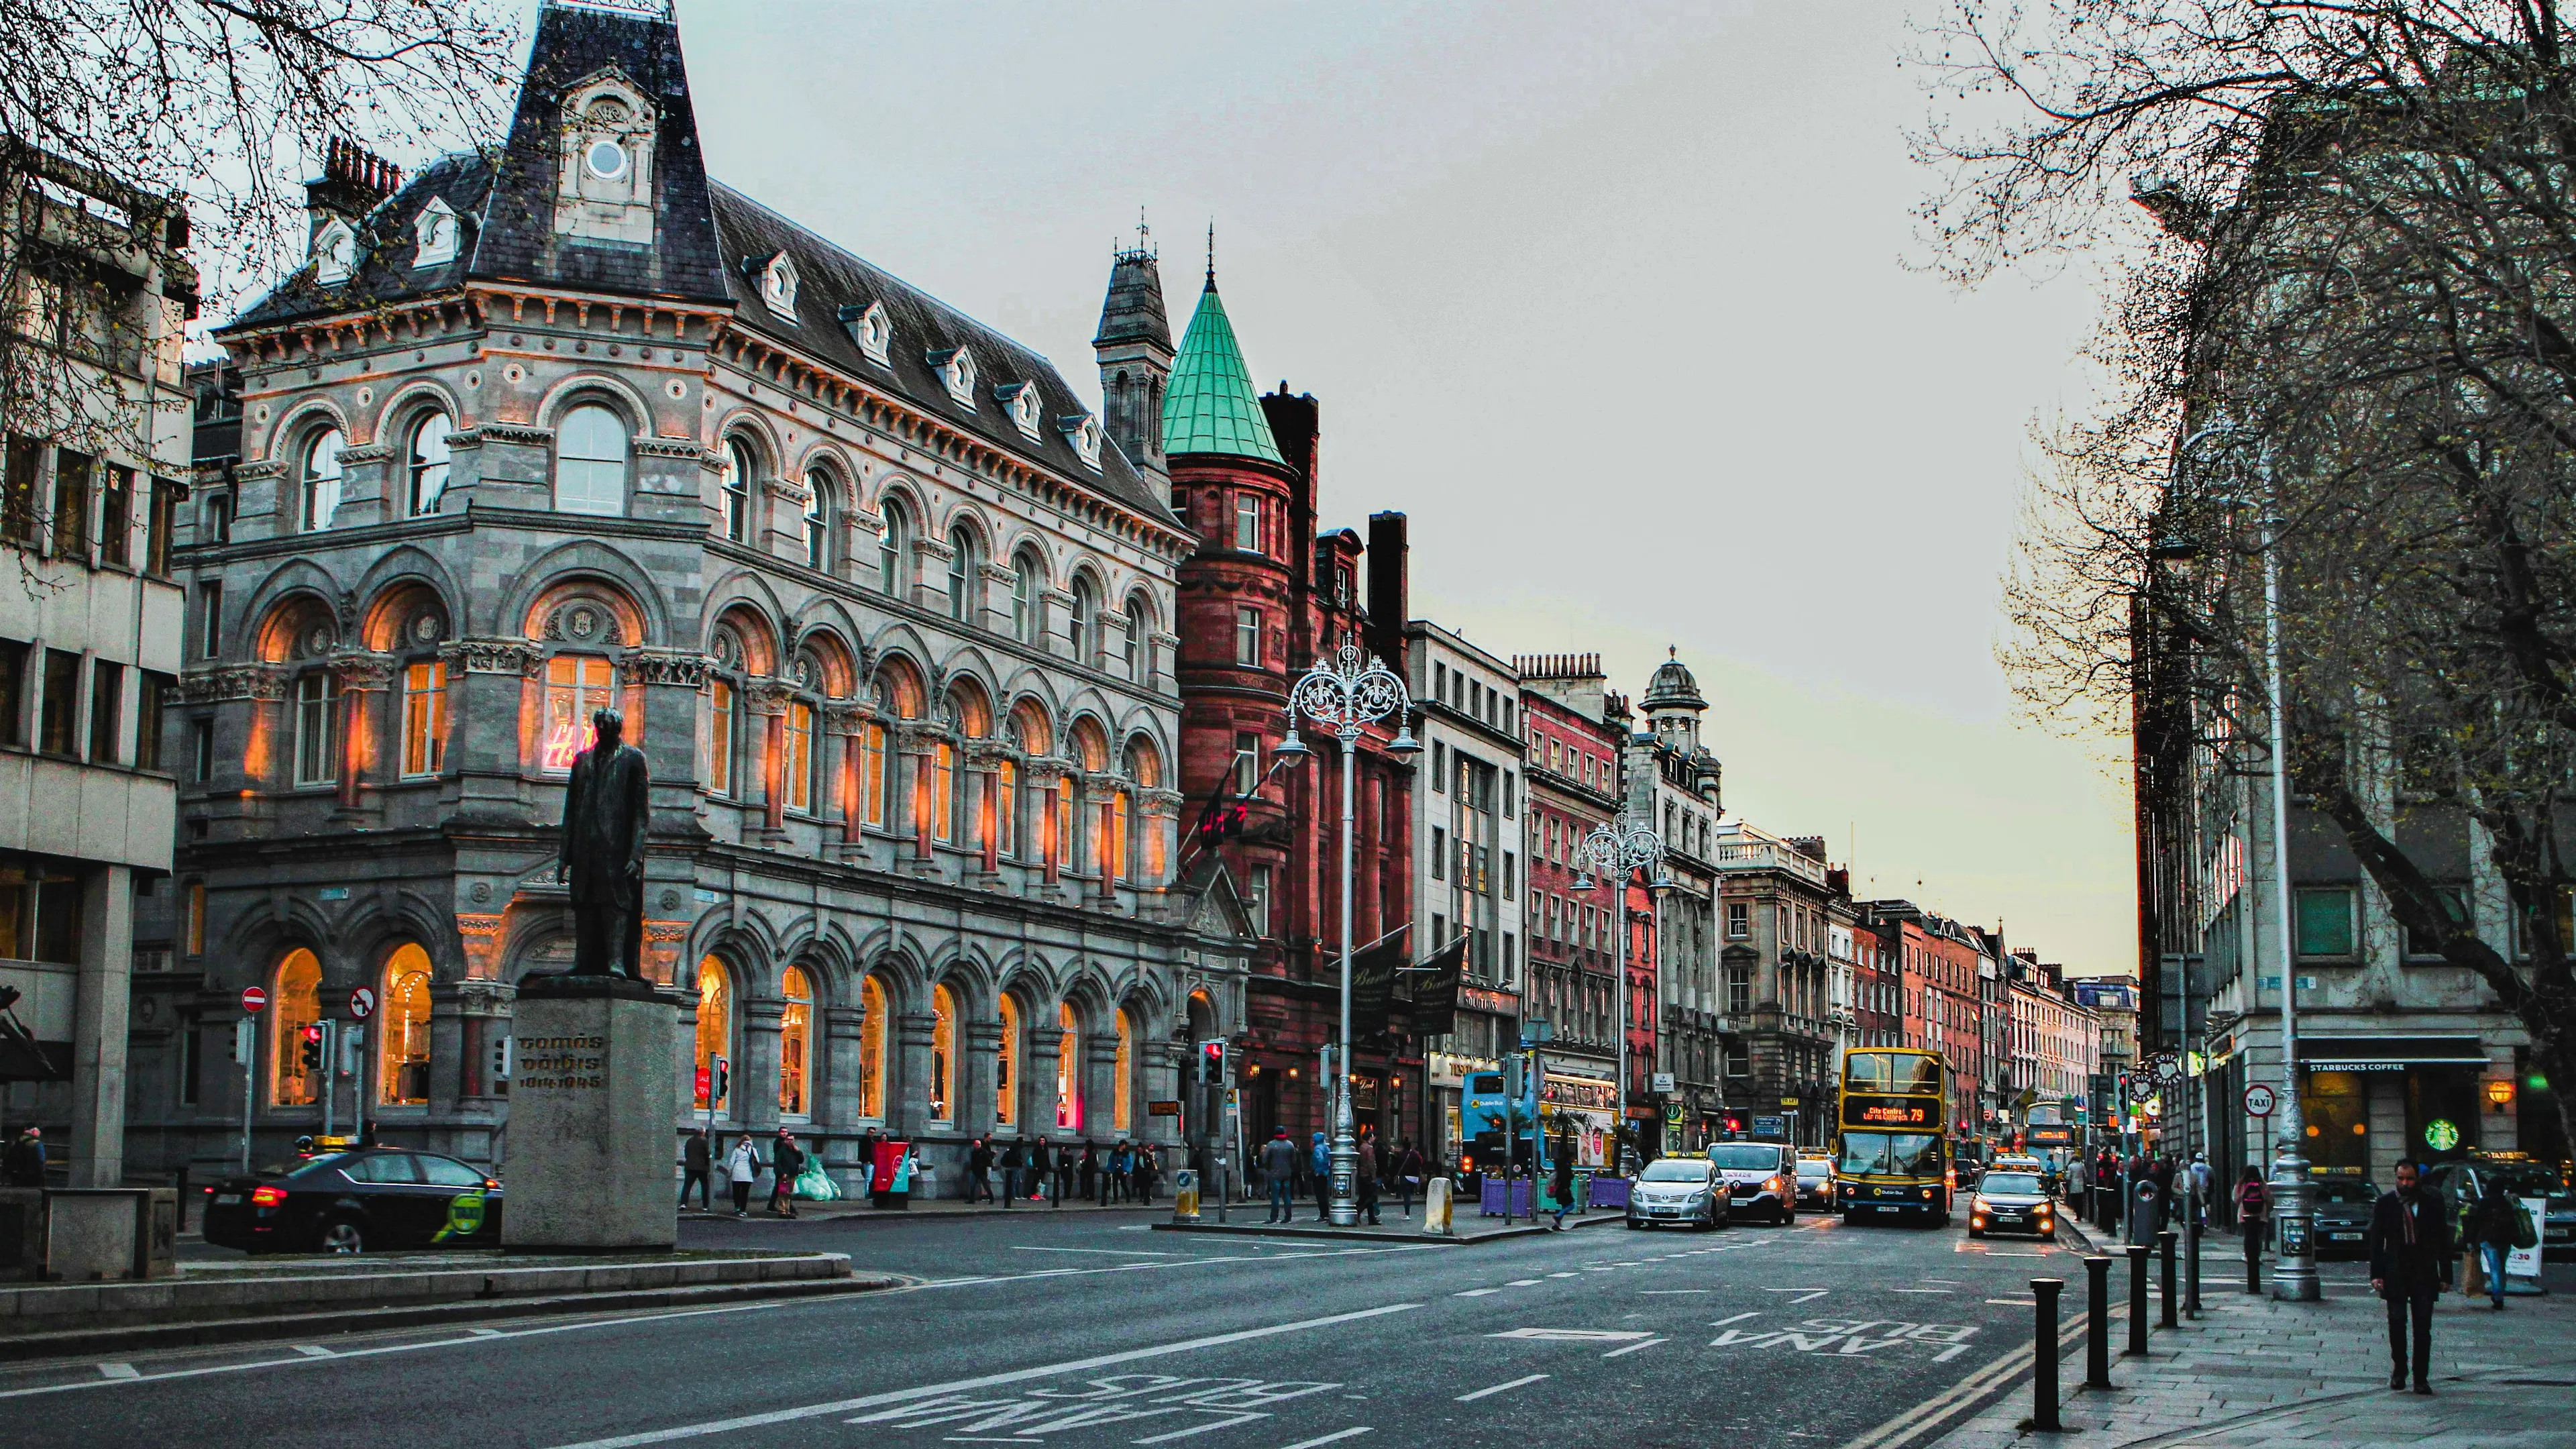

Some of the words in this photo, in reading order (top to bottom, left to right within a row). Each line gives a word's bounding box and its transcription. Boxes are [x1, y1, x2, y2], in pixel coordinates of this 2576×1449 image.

[1465, 996, 1499, 1010] SOLUTIONS
[2155, 1055, 2178, 1063] COSTA
[2132, 1075, 2151, 1083] COSTA
[2153, 1073, 2182, 1085] COFFEE
[2248, 1097, 2269, 1108] TAXI
[1911, 1108, 1923, 1121] 79
